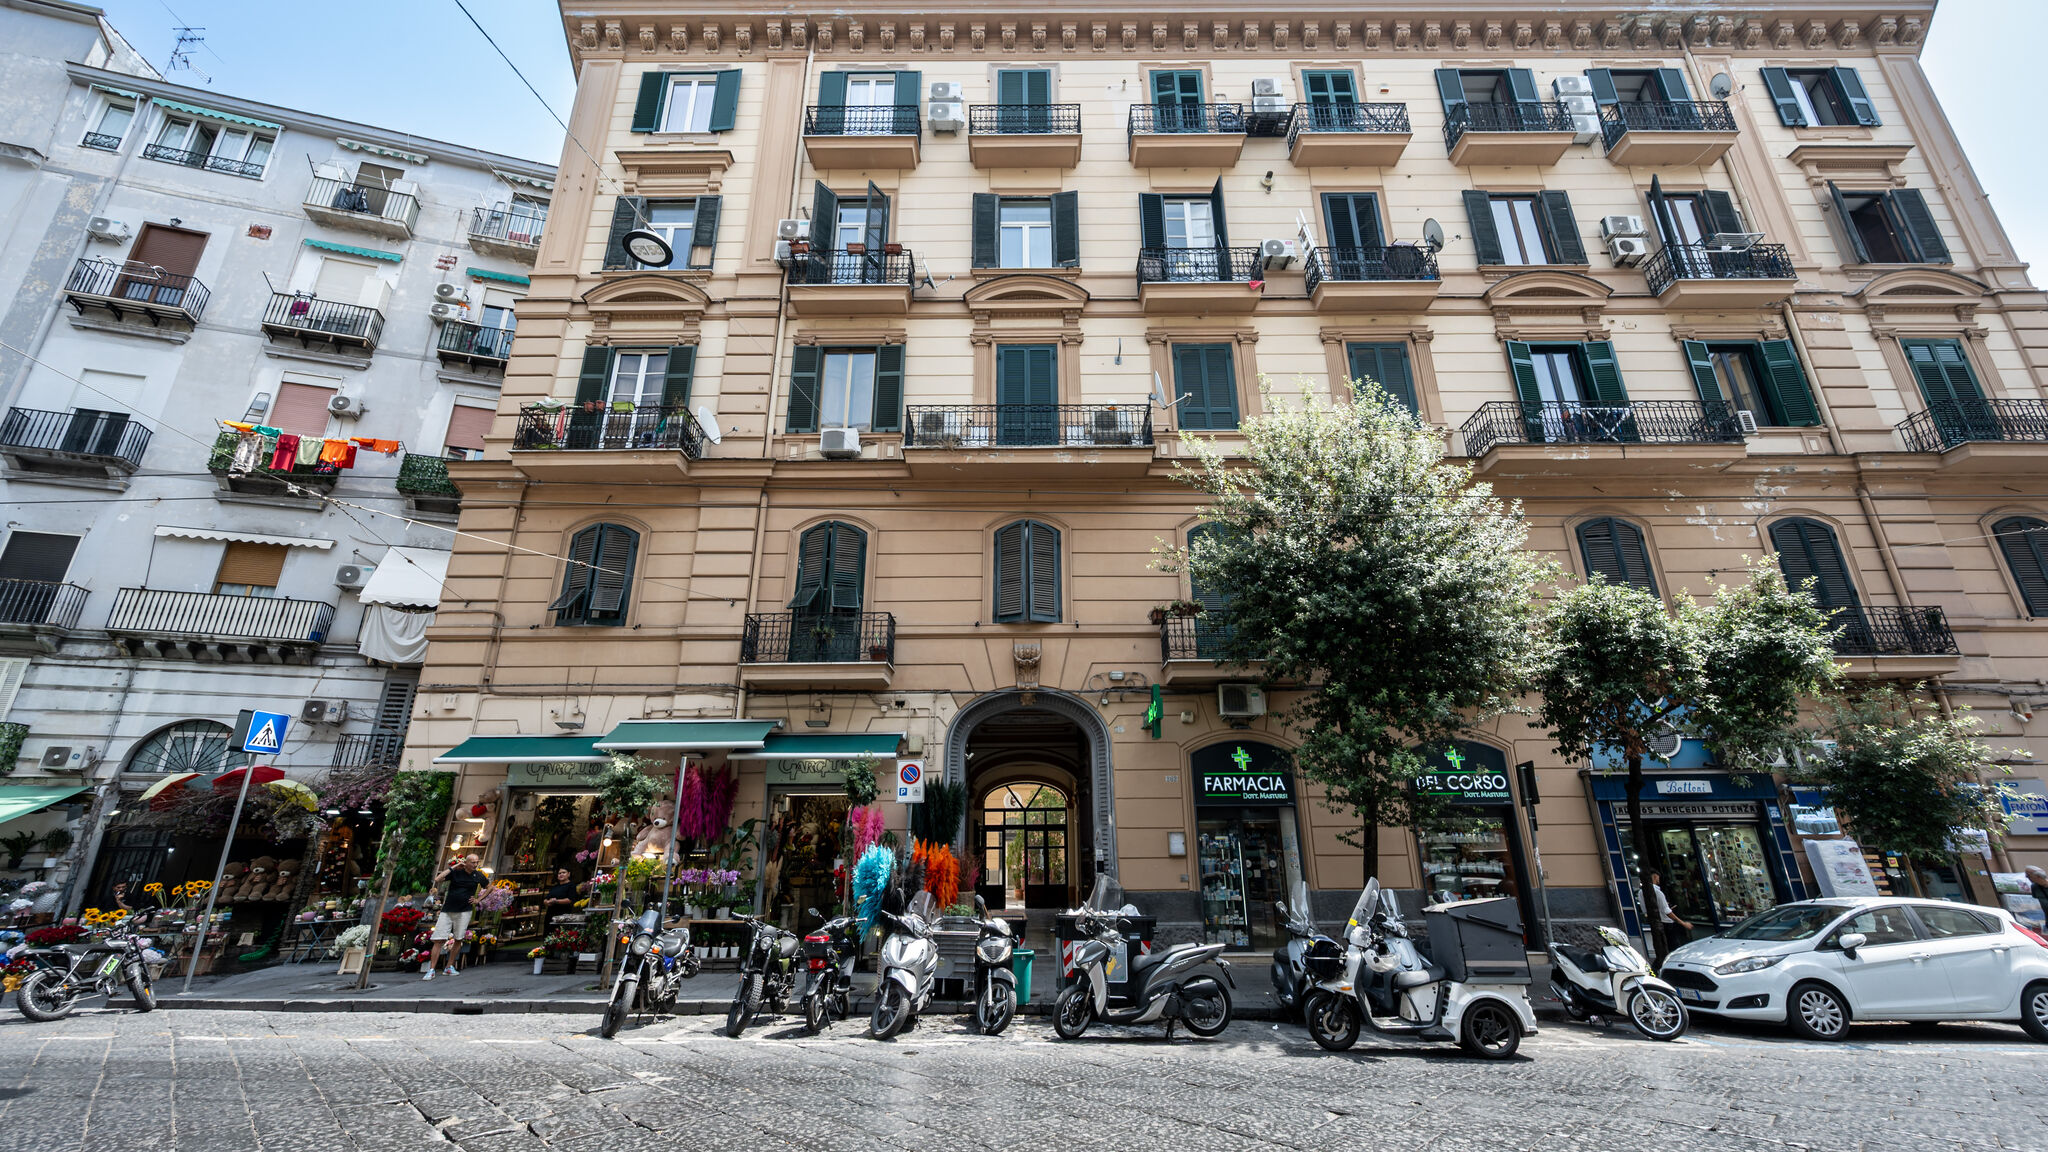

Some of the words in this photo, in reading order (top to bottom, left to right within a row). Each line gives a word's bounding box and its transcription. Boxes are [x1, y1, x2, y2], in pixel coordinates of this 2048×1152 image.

[1204, 776, 1286, 791] FARMACIA
[1416, 775, 1443, 790] DEL
[1447, 775, 1507, 790] CORSO
[1666, 781, 1706, 792] Bottoni
